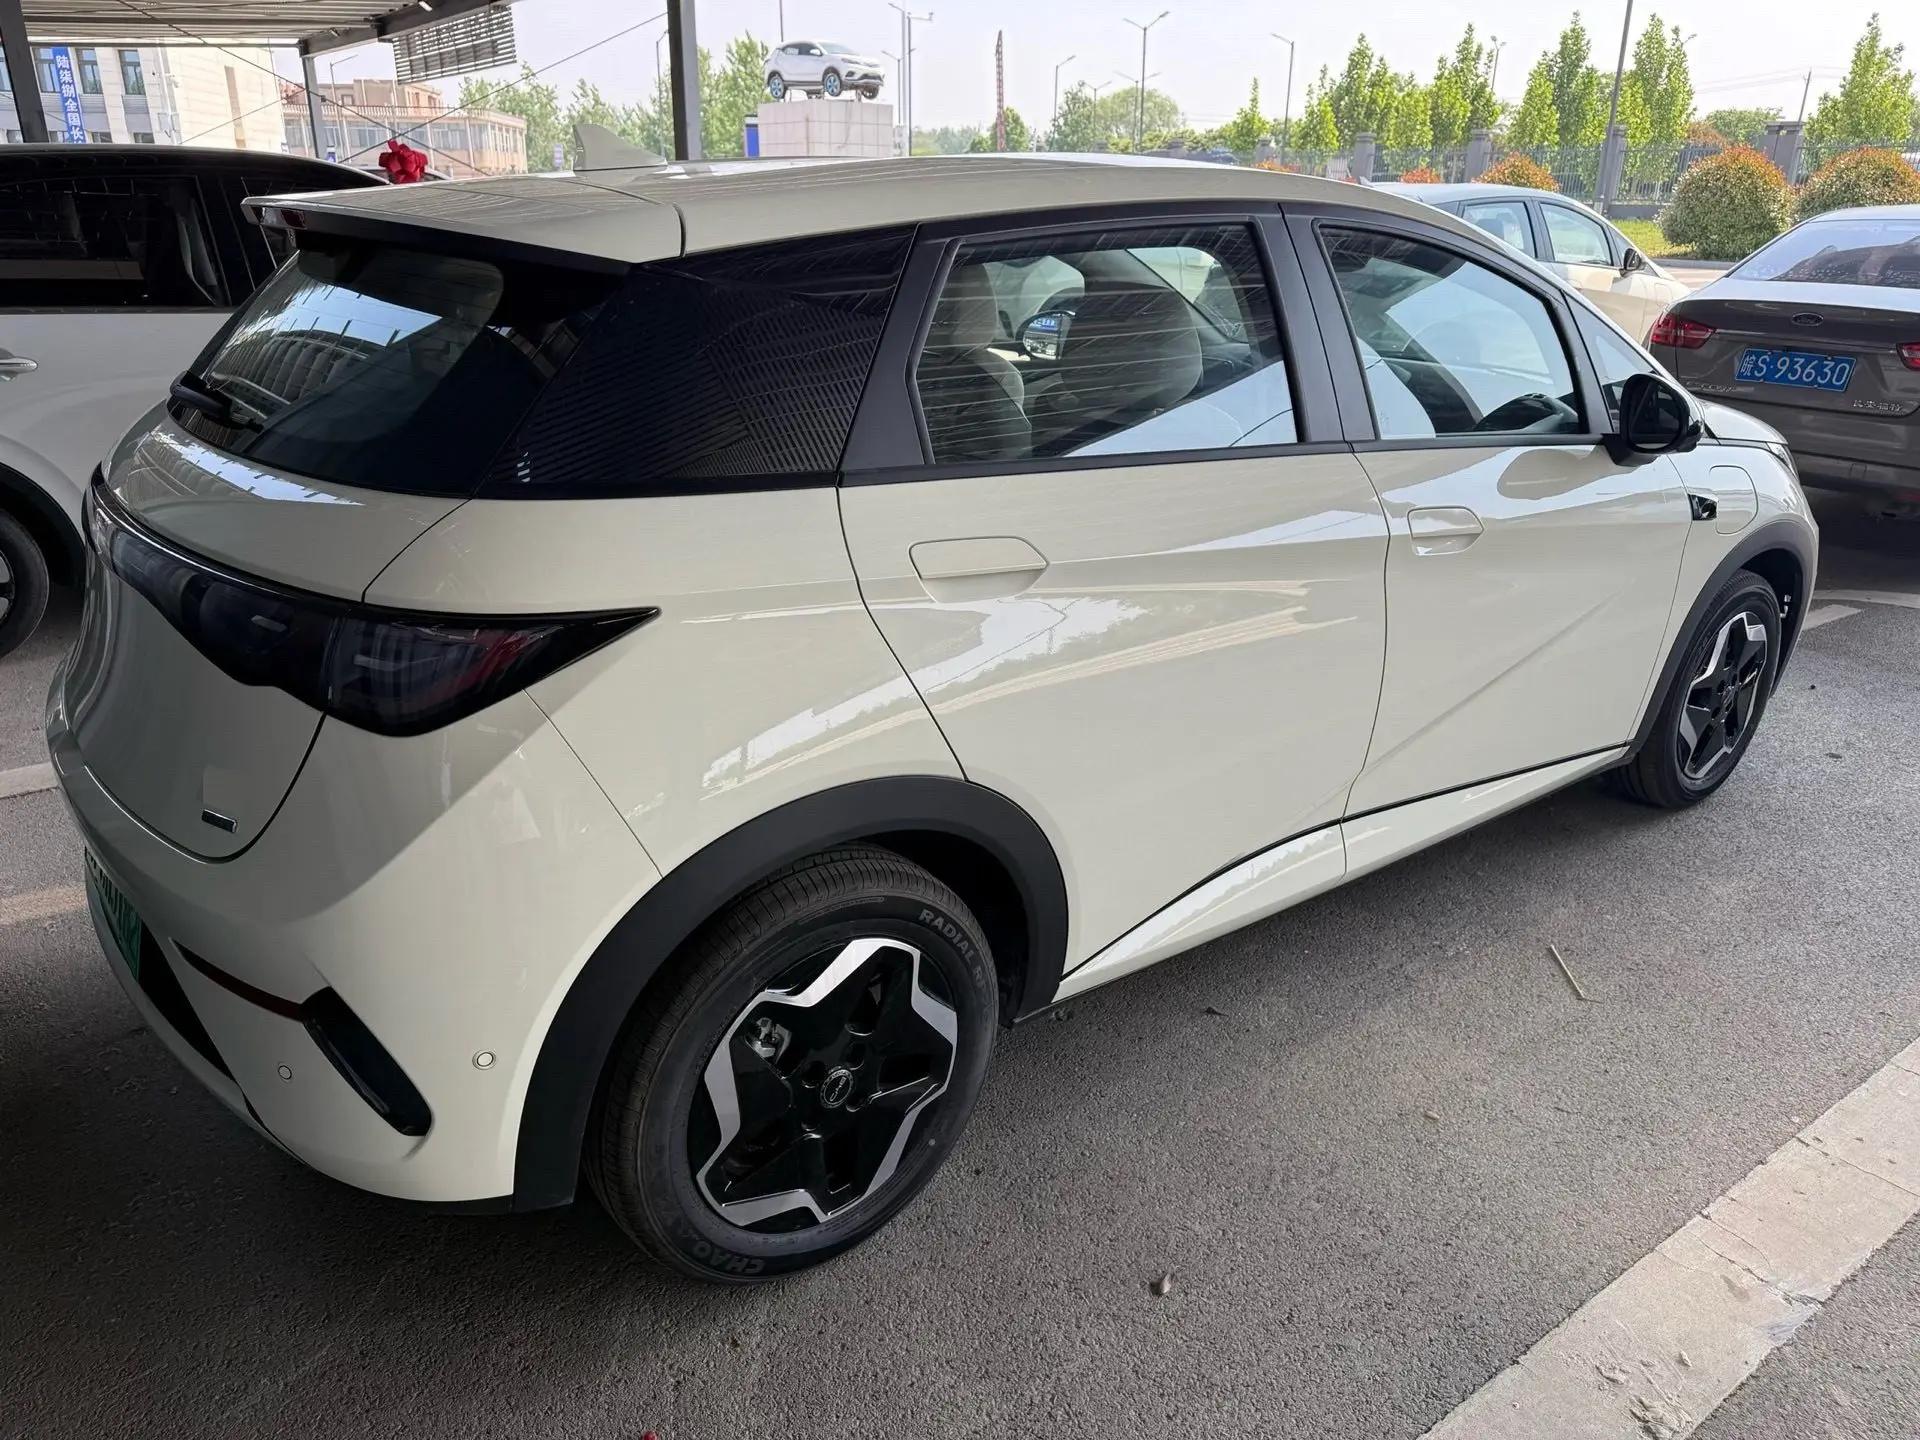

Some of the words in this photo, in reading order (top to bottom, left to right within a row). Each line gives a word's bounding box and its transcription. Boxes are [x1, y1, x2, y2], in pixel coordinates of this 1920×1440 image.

[56, 54, 84, 144] 陆柒捌全国长
[918, 908, 974, 965] RADIAL
